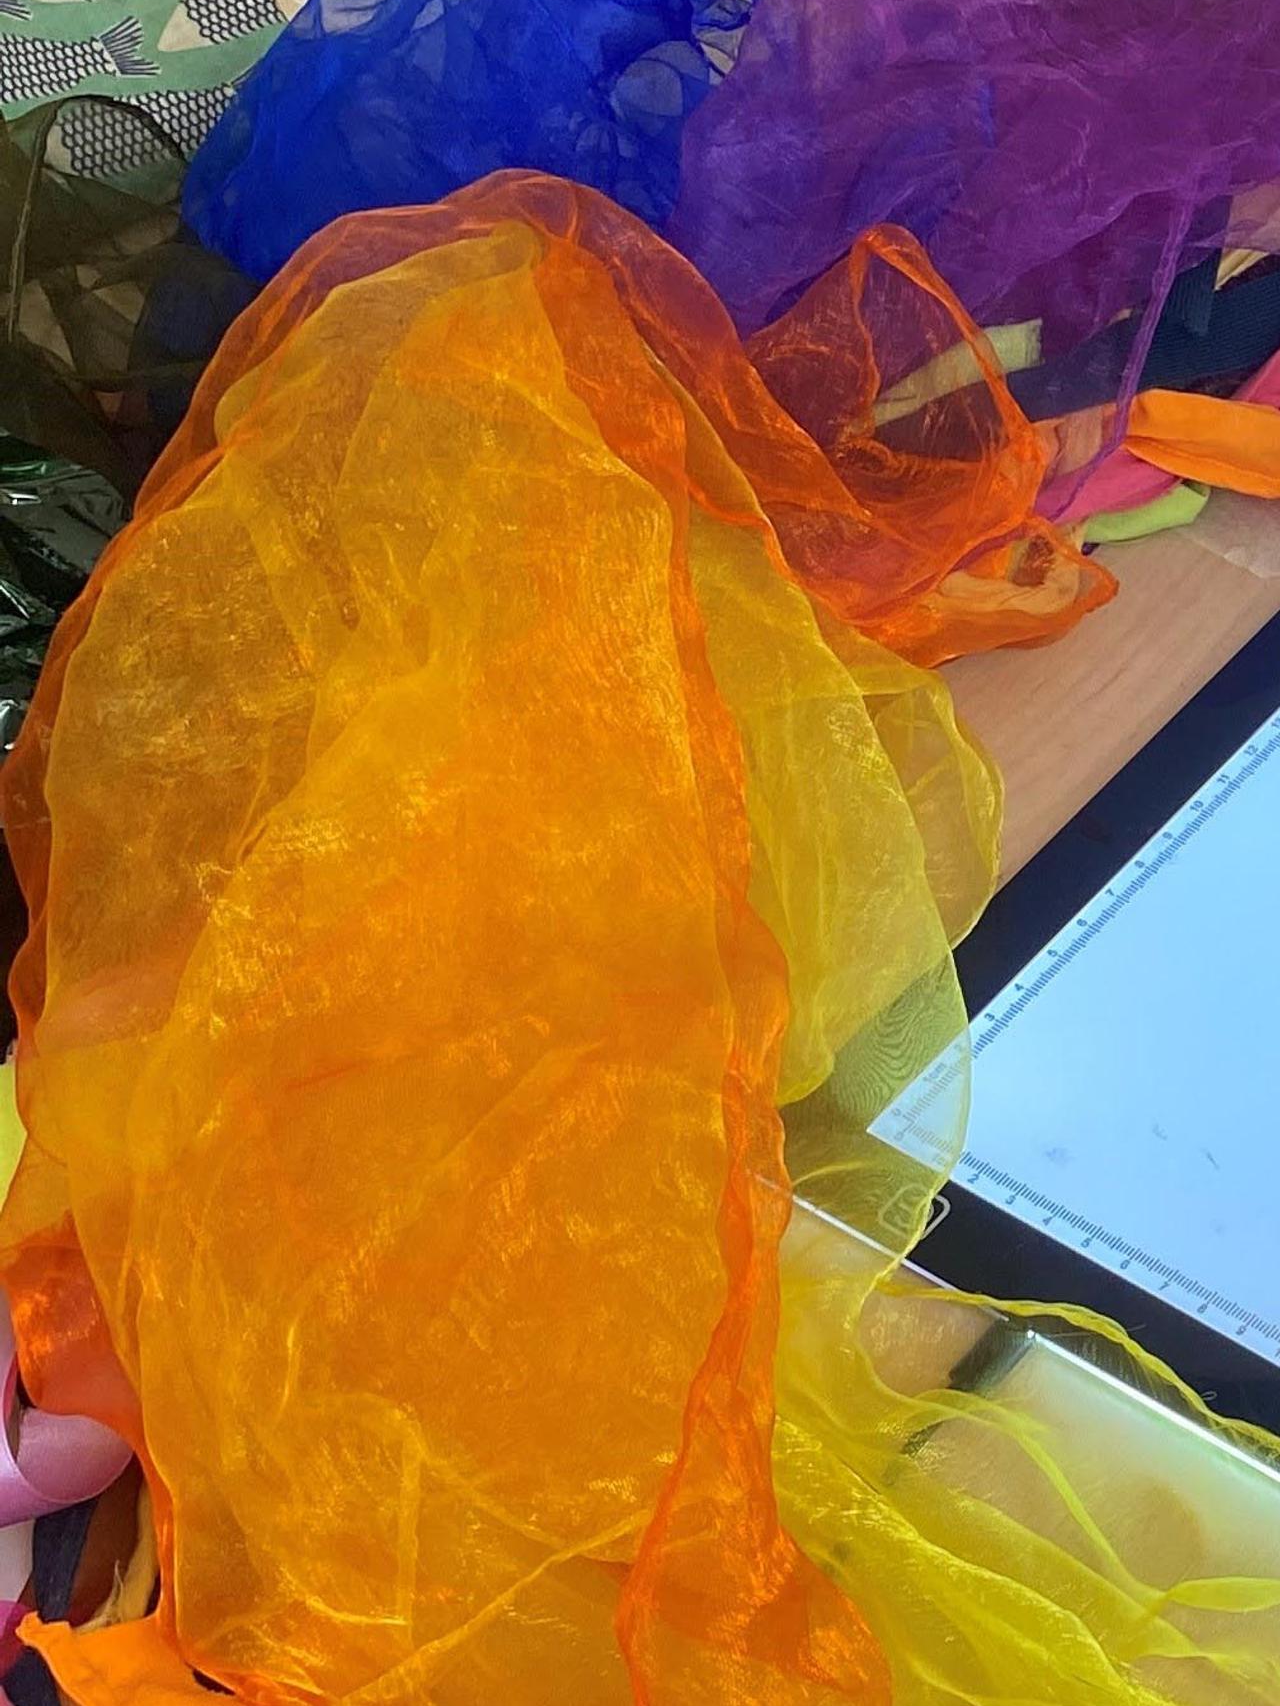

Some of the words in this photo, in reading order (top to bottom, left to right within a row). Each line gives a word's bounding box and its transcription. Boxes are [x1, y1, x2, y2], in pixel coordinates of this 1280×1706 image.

[967, 1173, 980, 1184] 2
[1005, 1194, 1017, 1205] 3
[1043, 1216, 1054, 1226] 4
[1080, 1237, 1093, 1249] 5
[1120, 1259, 1131, 1270] 6
[1159, 1281, 1171, 1291] 7
[1197, 1303, 1208, 1314] 8
[1235, 1325, 1248, 1336] 9
